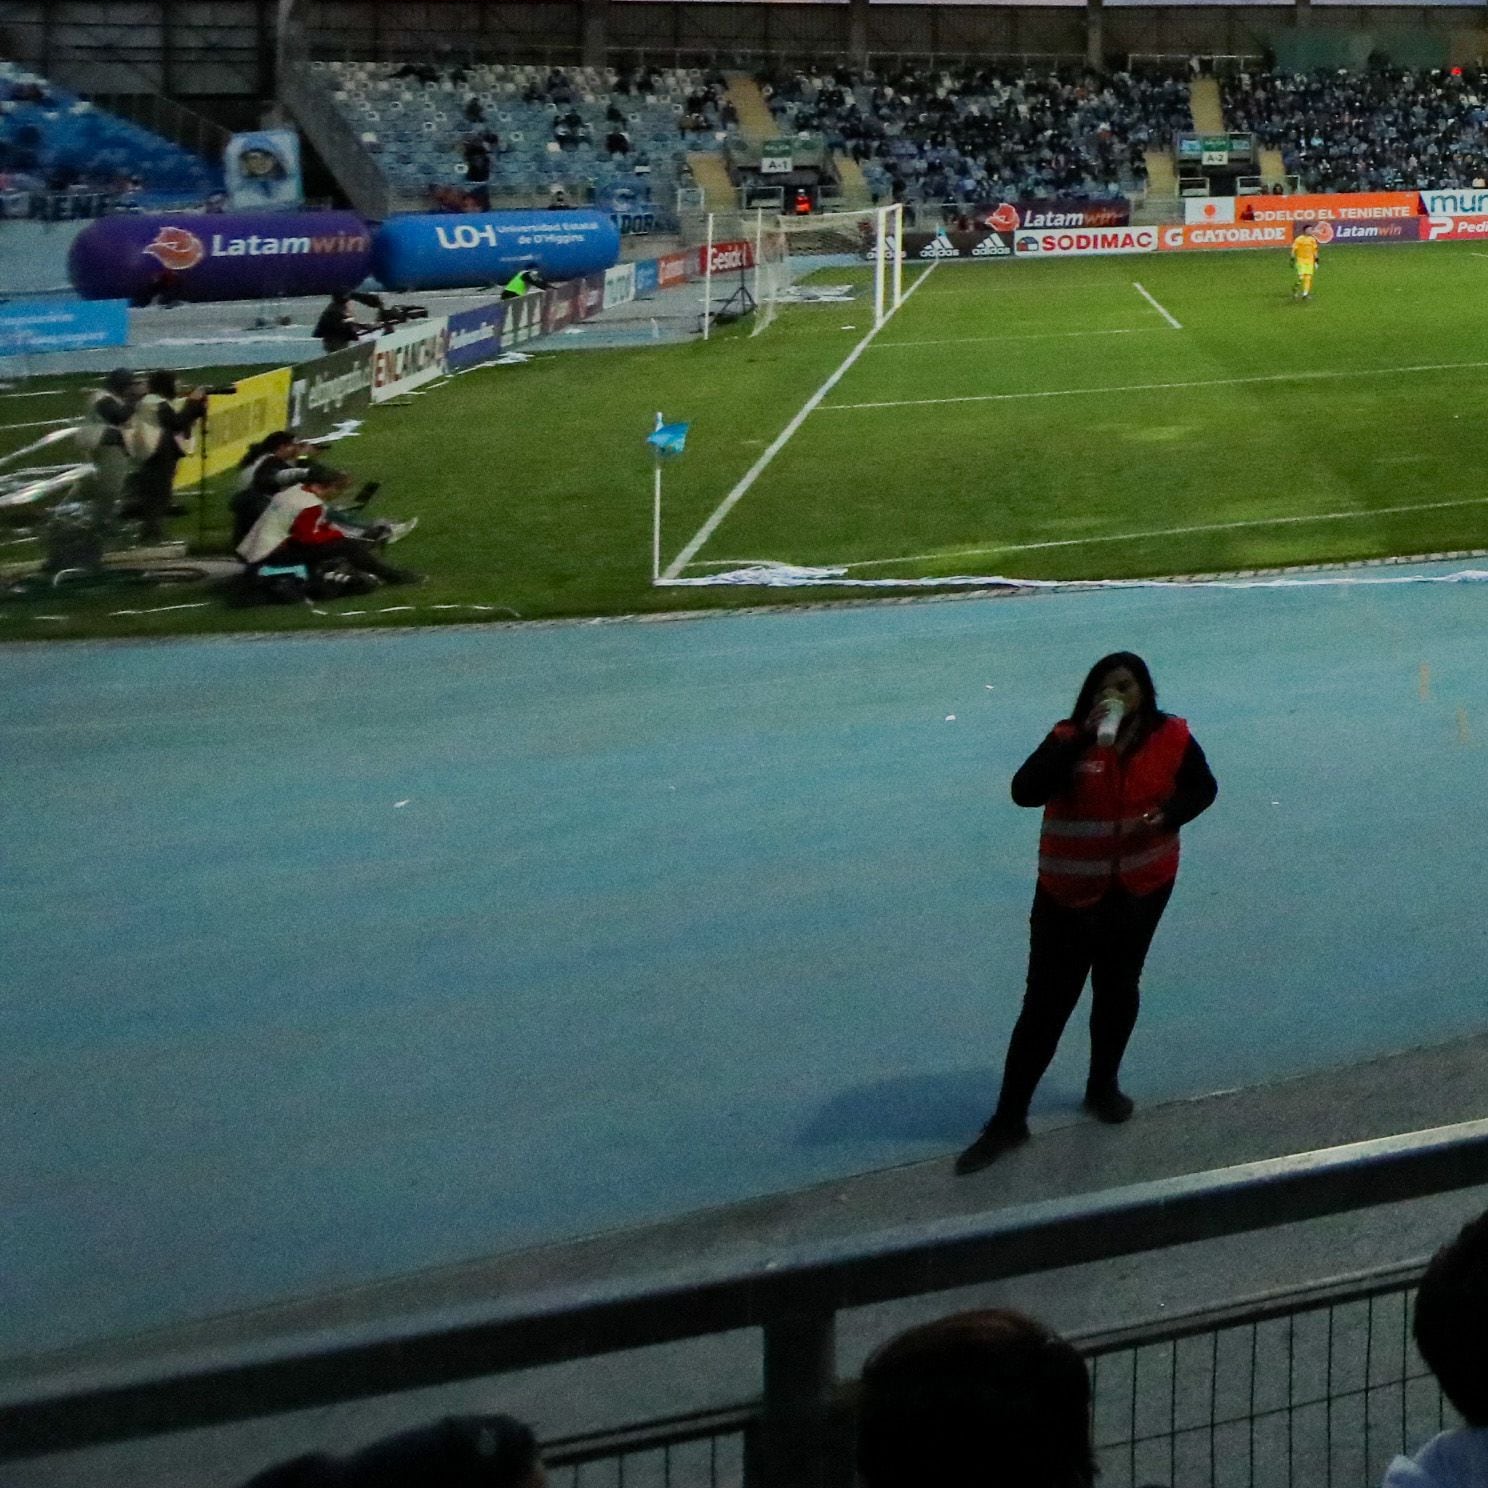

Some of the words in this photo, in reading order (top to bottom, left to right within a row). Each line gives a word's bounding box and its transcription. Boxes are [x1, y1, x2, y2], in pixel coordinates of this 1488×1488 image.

[1206, 151, 1224, 162] A-2
[768, 159, 788, 170] A-1
[1320, 209, 1336, 221] EL
[1340, 206, 1410, 219] TENIENTE
[1190, 225, 1286, 244] GATORADE
[1336, 224, 1402, 238] Latamwin
[211, 231, 365, 257] Latamwin
[1042, 232, 1152, 251] SODIMAC
[920, 248, 960, 258] adidas
[972, 245, 1010, 256] adidas
